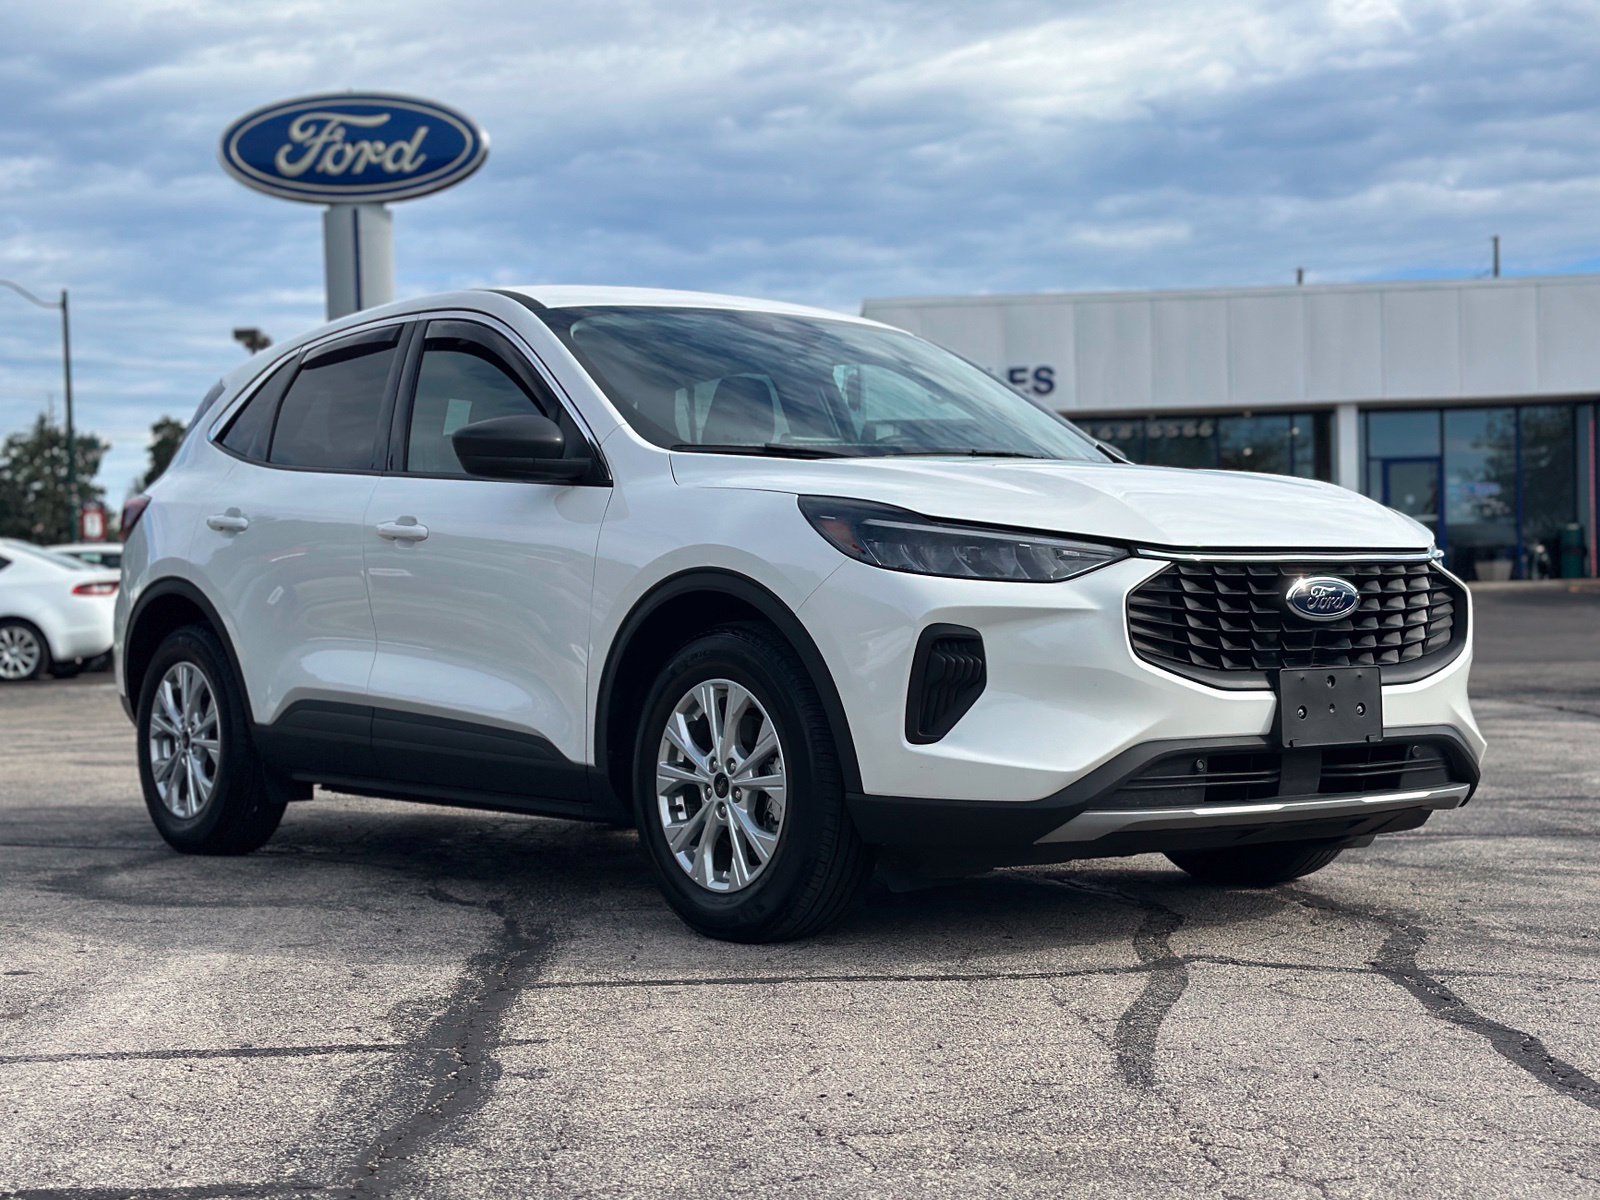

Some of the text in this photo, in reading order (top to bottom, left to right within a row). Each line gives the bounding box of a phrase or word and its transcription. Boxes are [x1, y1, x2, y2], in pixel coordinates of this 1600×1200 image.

[275, 112, 428, 177] Ford
[987, 366, 1055, 394] ES
[1307, 585, 1346, 609] Ford
